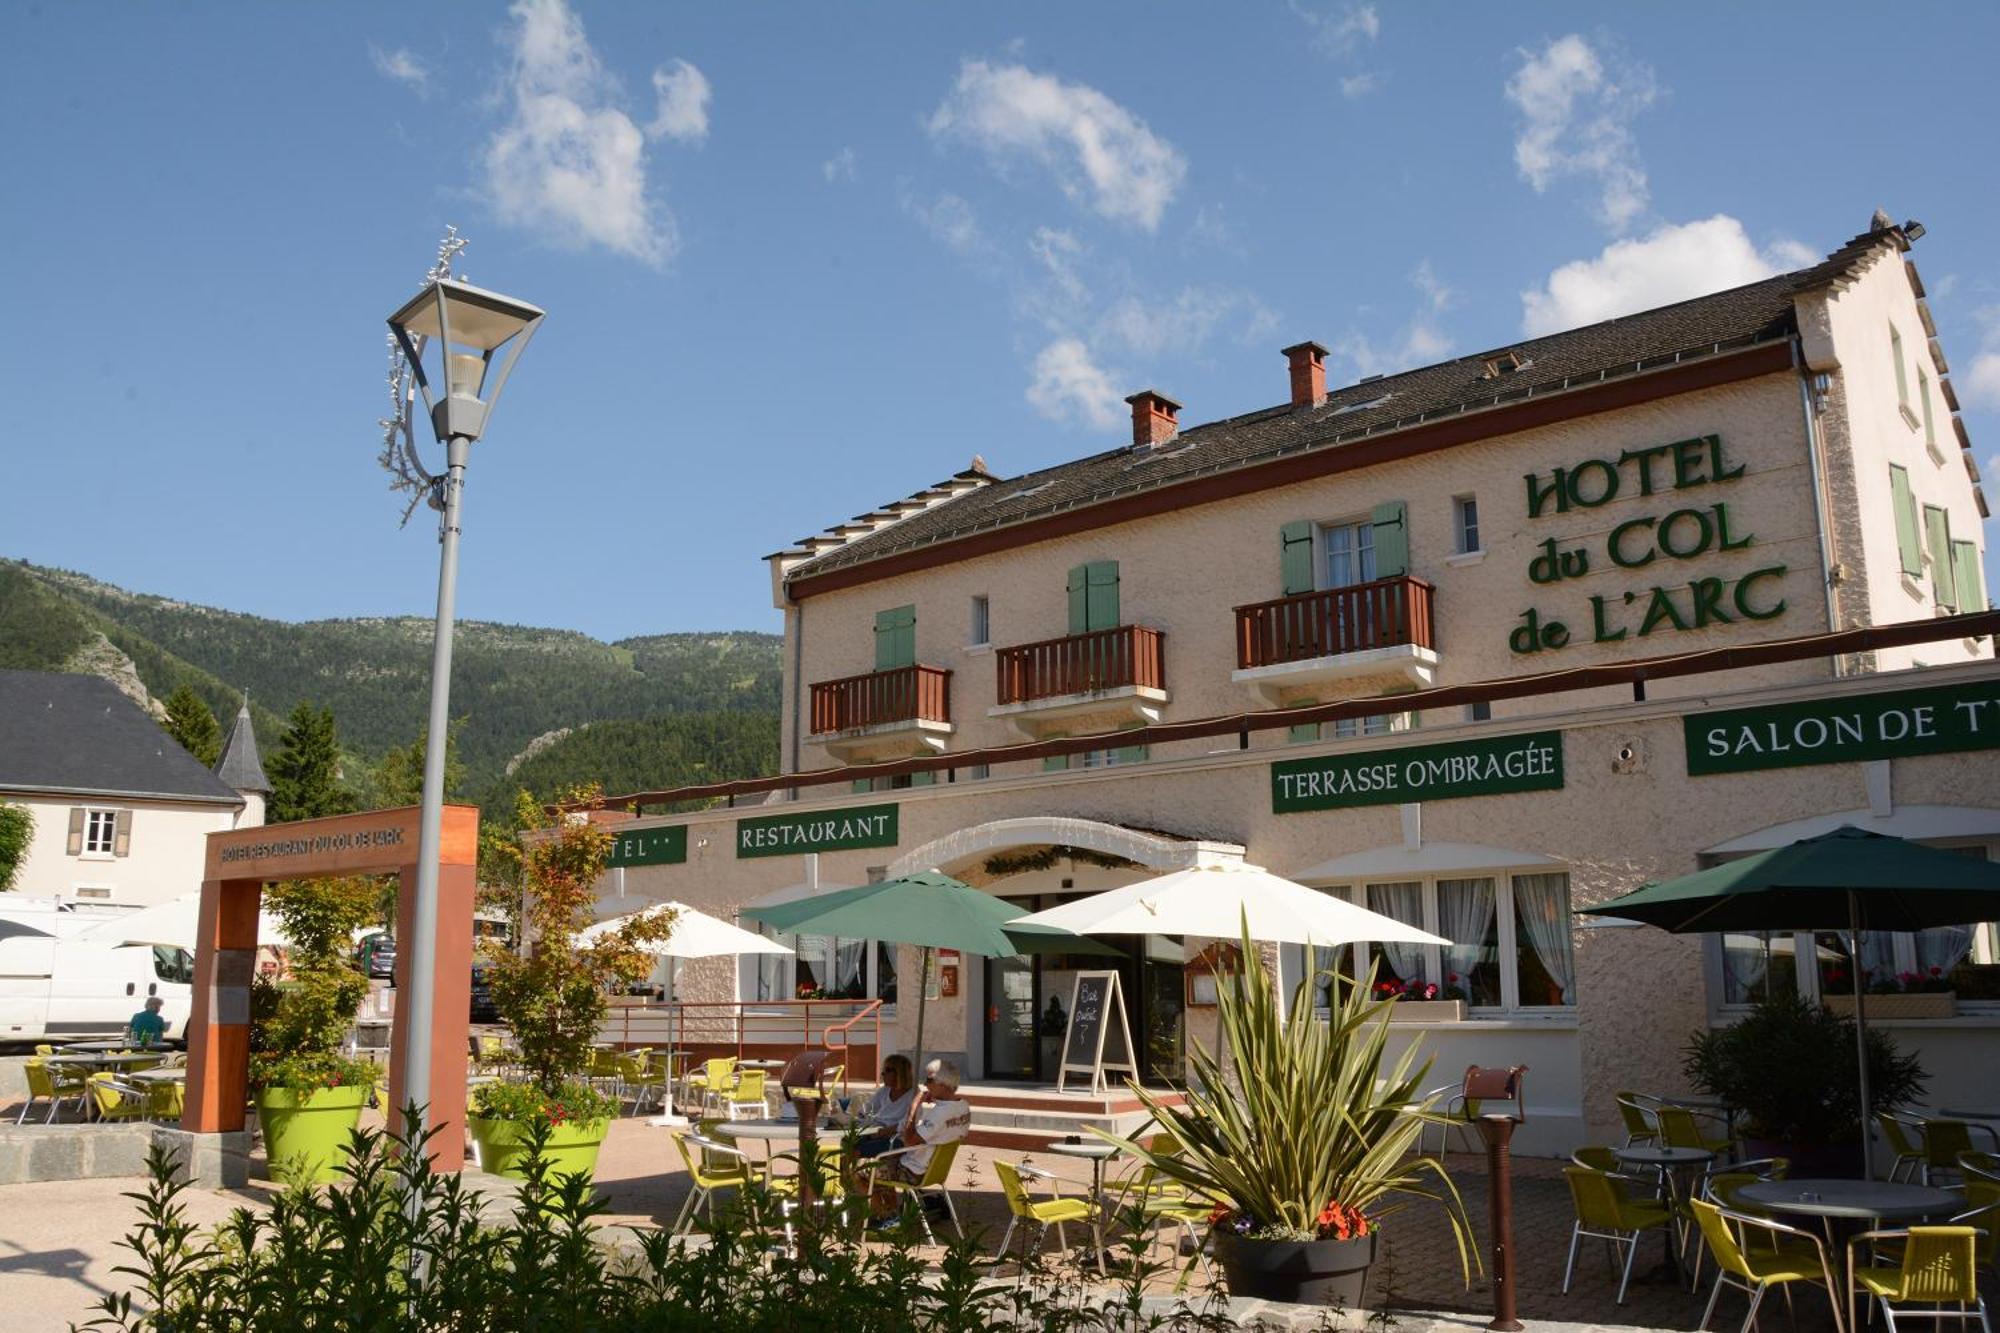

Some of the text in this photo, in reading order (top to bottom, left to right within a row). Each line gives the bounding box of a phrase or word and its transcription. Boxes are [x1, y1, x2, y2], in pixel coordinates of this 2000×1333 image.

[1523, 434, 1746, 518] HOTEL
[1528, 502, 1754, 584] du COL
[1509, 565, 1787, 653] de L'ARC
[1707, 699, 2000, 757] SALON DE T
[1278, 741, 1554, 799] TERRASSE OMBRAGÉE
[249, 838, 313, 859] RESTAURANT
[314, 834, 330, 850] DU
[331, 832, 352, 849] COL
[353, 831, 370, 848] DE
[608, 839, 646, 859] TEL
[741, 815, 890, 849] RESTAURANT
